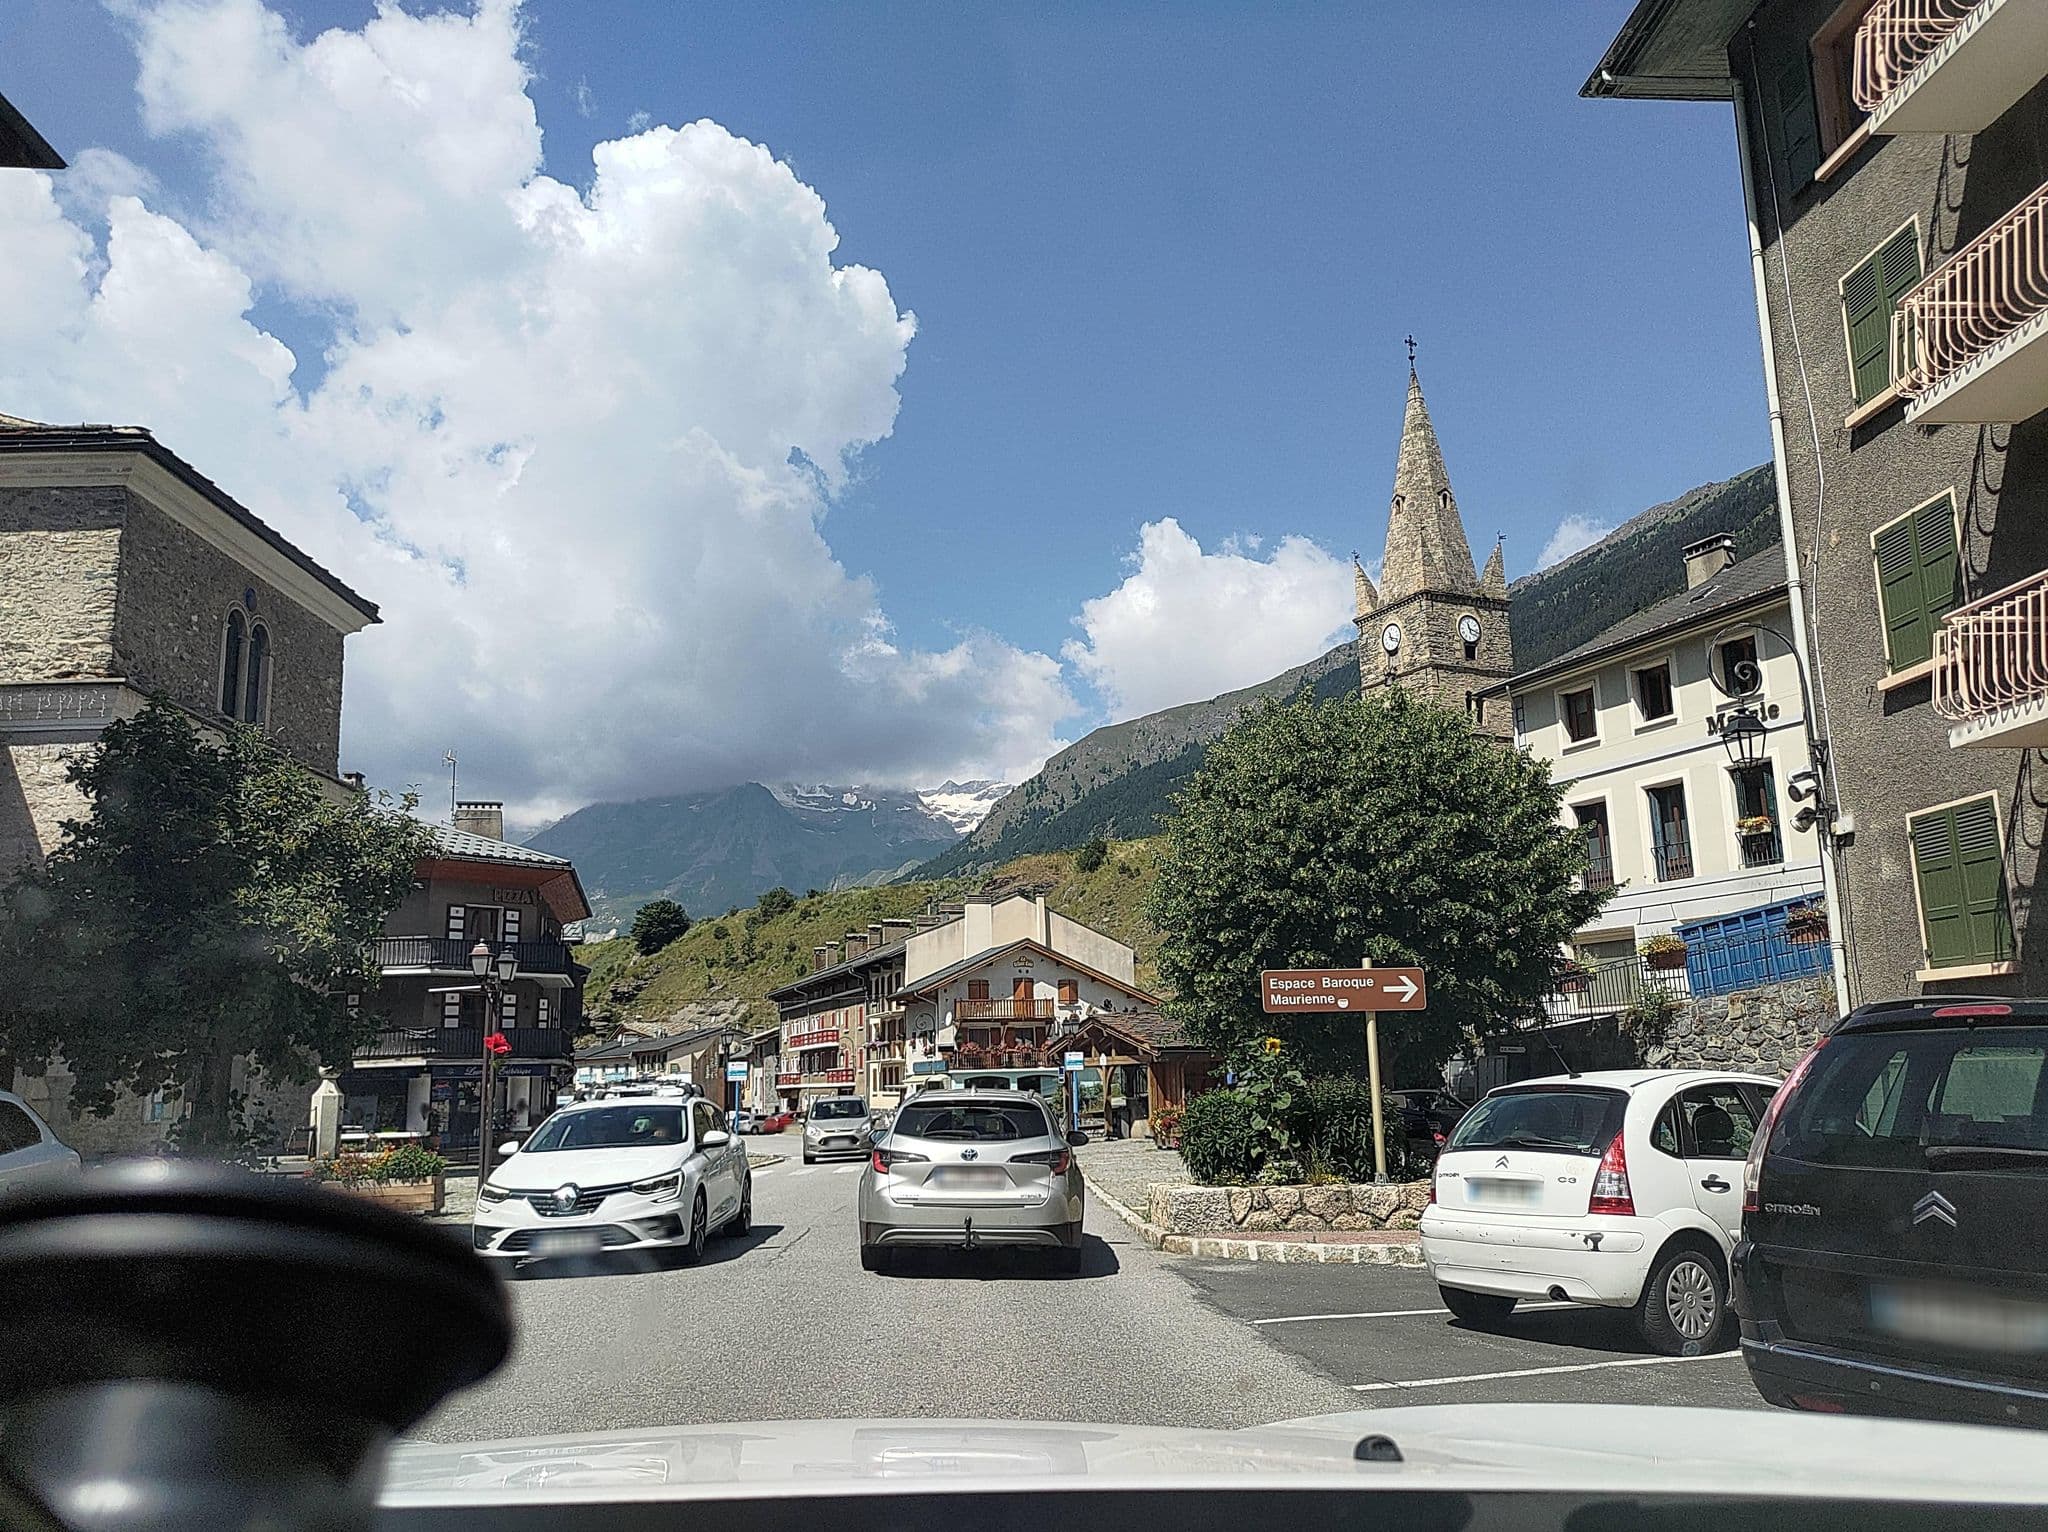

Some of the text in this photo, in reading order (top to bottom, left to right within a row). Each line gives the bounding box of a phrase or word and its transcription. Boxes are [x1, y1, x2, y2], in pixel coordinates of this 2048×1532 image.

[1269, 976, 1375, 991] Espace Baroque
[1270, 993, 1335, 1006] Maurienne
[1557, 1176, 1577, 1184] C3
